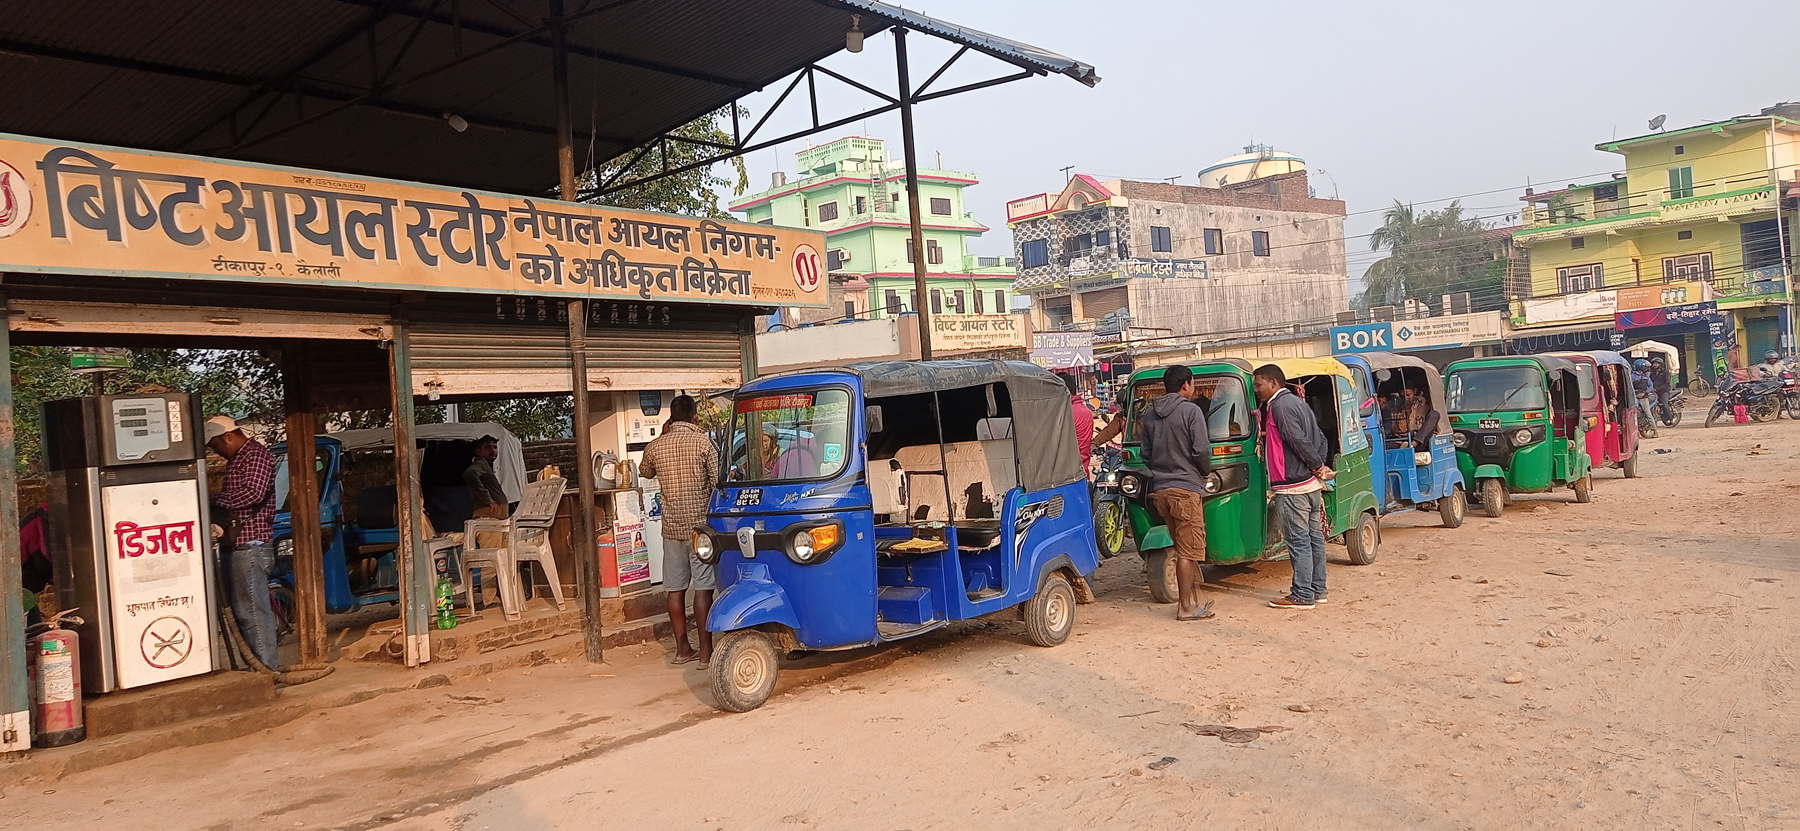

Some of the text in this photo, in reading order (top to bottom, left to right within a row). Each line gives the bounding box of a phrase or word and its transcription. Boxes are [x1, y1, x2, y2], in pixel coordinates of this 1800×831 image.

[35, 147, 511, 271] बिष्ट आयल स्टोर
[509, 199, 603, 246] नेपाल
[608, 218, 692, 254] आयल
[295, 259, 341, 279] कैलाली
[516, 244, 752, 299] को अधिकृत बिक्रेता
[960, 319, 989, 332] आयल
[991, 317, 1015, 331] स्टोर
[1414, 329, 1427, 337] BANK
[1433, 327, 1461, 335] KATHMANDU
[1043, 335, 1060, 349] Trade
[1061, 335, 1065, 348] &
[1066, 334, 1092, 351] Suppliers
[1336, 328, 1388, 351] BOK
[800, 487, 816, 499] NXT
[114, 520, 195, 559] डिजल
